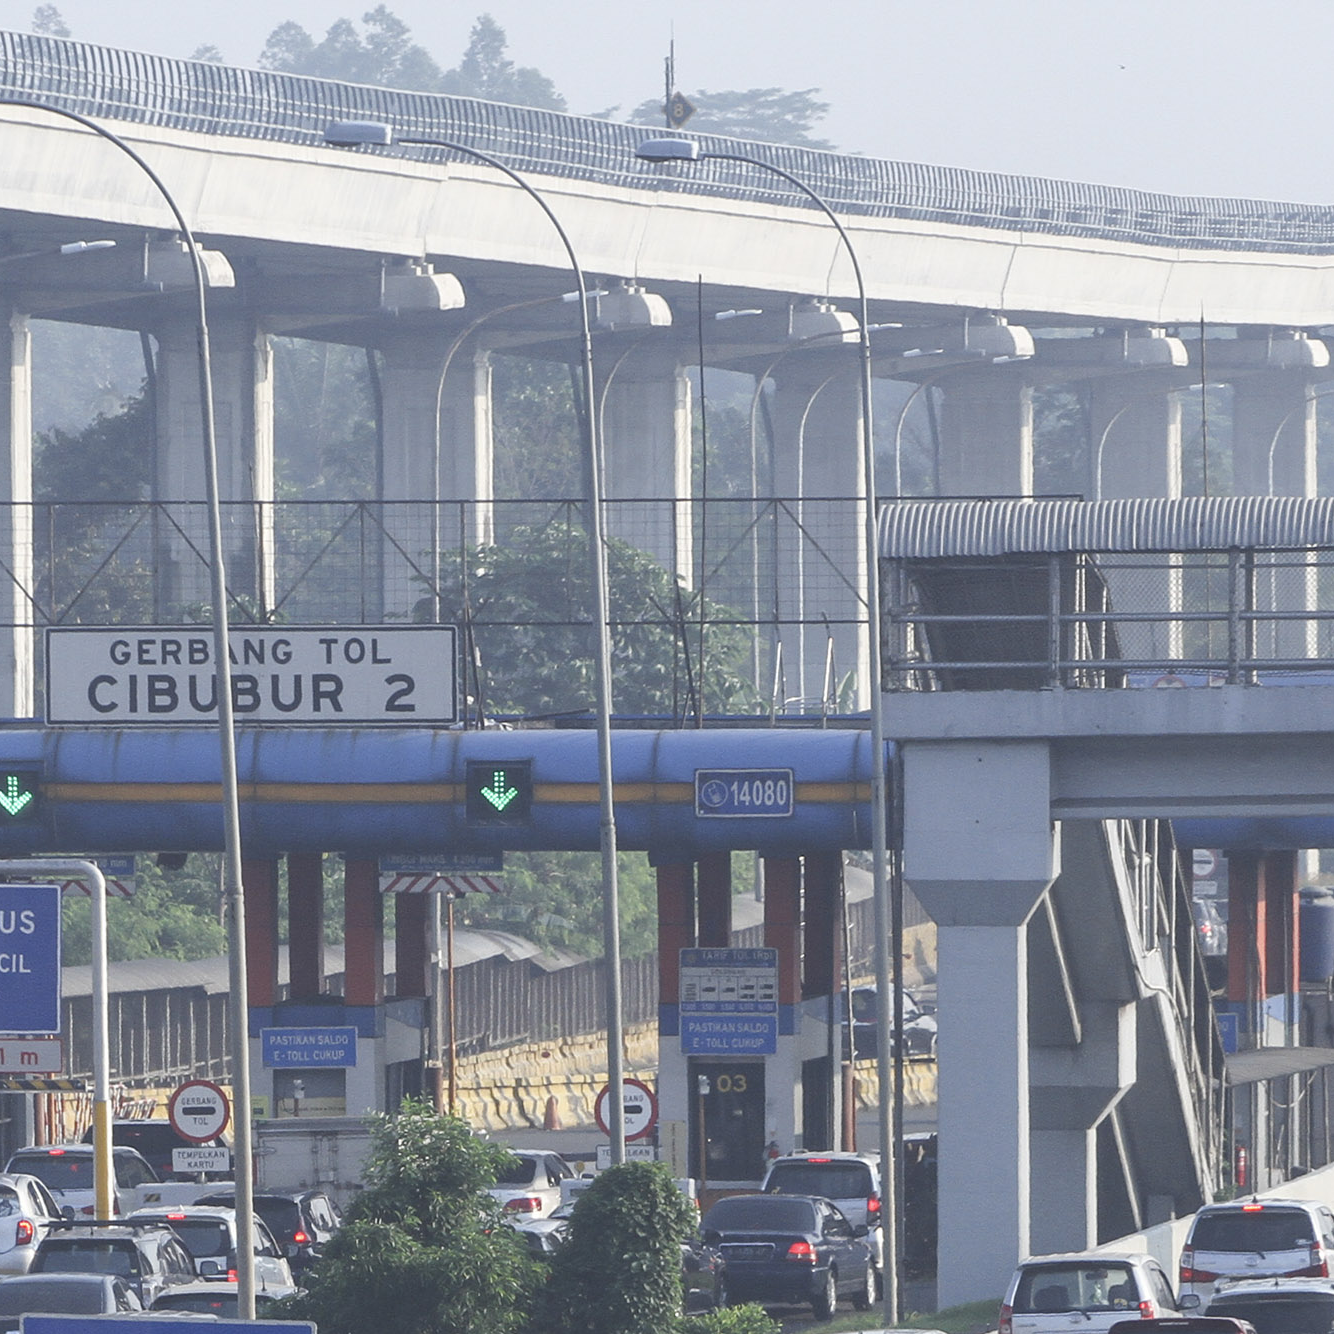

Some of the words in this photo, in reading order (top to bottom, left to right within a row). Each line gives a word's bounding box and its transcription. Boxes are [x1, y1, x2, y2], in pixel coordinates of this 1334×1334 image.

[319, 638, 393, 665] TOL
[87, 673, 344, 713] CIBUBUR
[384, 674, 416, 712] 2
[730, 780, 787, 806] 14080
[732, 951, 748, 960] TOL
[688, 1022, 735, 1033] PASTIKAN
[736, 1022, 769, 1033] SALDO
[269, 1035, 316, 1045] PASTIKAN
[317, 1034, 349, 1044] SALDO
[731, 1038, 765, 1048] CUKUP
[21, 1051, 39, 1065] m
[312, 1050, 345, 1060] CUKUP
[717, 1074, 747, 1092] 03
[181, 1097, 217, 1105] GERBANG
[192, 1117, 208, 1125] TOL
[177, 1151, 225, 1159] TEMPELKAN
[187, 1160, 214, 1169] KARTU
